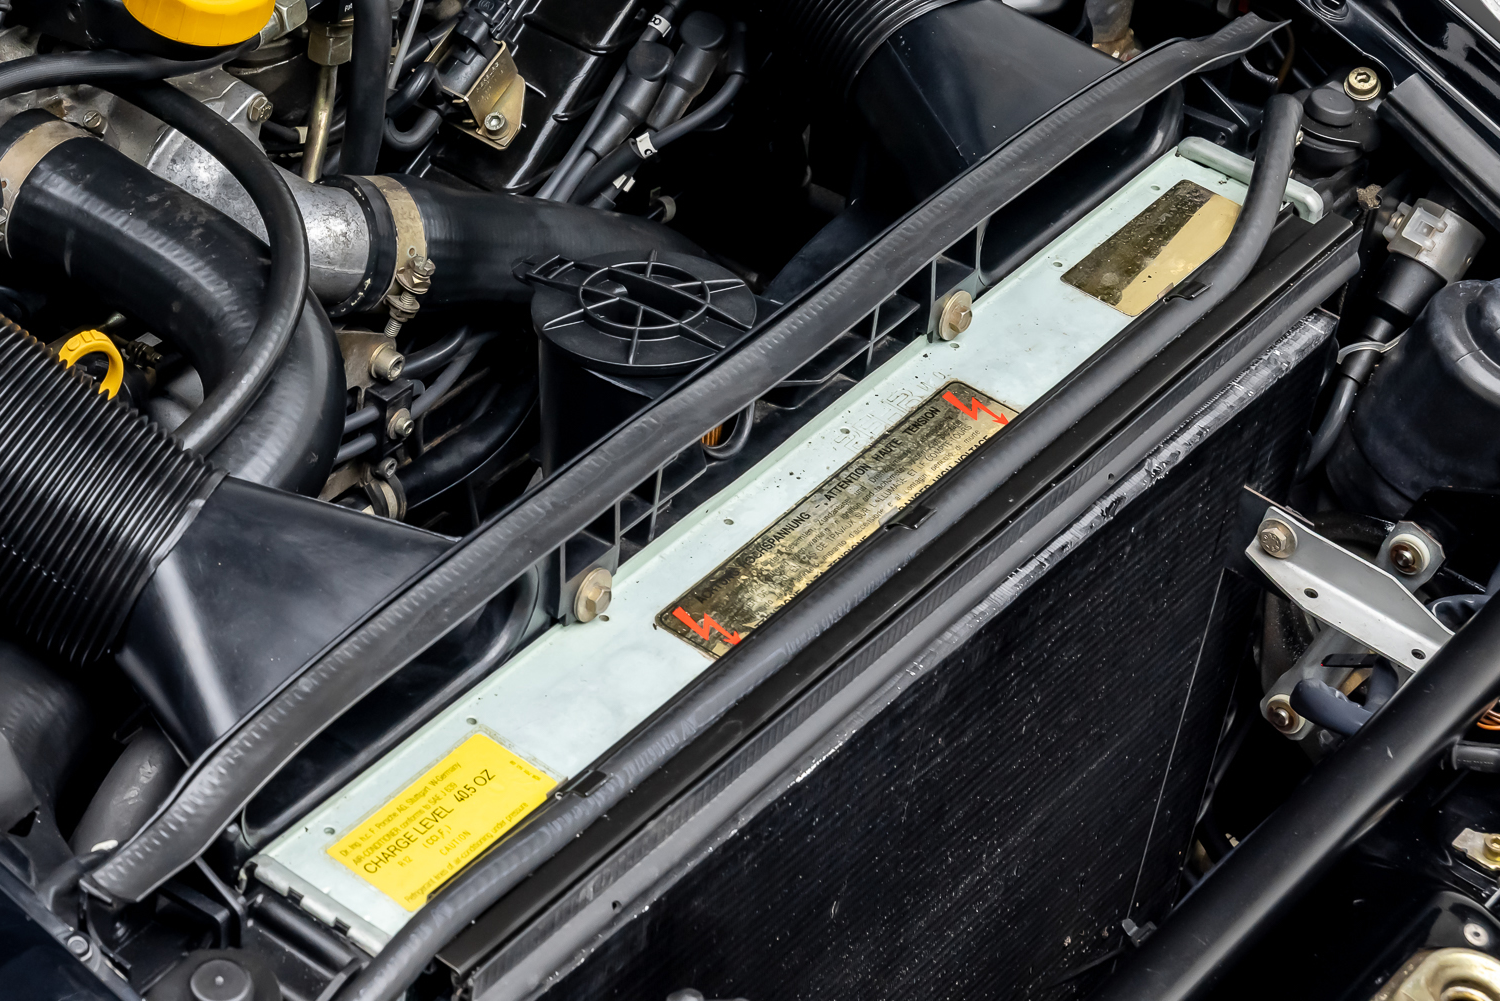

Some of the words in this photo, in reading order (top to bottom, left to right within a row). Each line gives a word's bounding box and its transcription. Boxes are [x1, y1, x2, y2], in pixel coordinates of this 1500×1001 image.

[736, 510, 811, 569] HOCHSPANNUNG
[821, 462, 872, 501] ATTENTION
[870, 437, 903, 461] HAUTE
[900, 405, 941, 437] TENSION
[853, 506, 871, 519] SUR
[906, 468, 918, 476] ET
[352, 826, 402, 866] AIR-CONDITIONER
[400, 808, 426, 830] conforms
[422, 802, 432, 812] to
[428, 794, 443, 807] SAE
[364, 831, 418, 874] CHARGE
[412, 806, 454, 834] LEVEL
[473, 768, 496, 786] OZ
[374, 811, 398, 830] Porsche
[406, 786, 431, 806] Stuttgart
[428, 762, 462, 786] W-Germany
[491, 820, 506, 836] under
[505, 802, 529, 822] pressure
[439, 830, 472, 856] CAUTION
